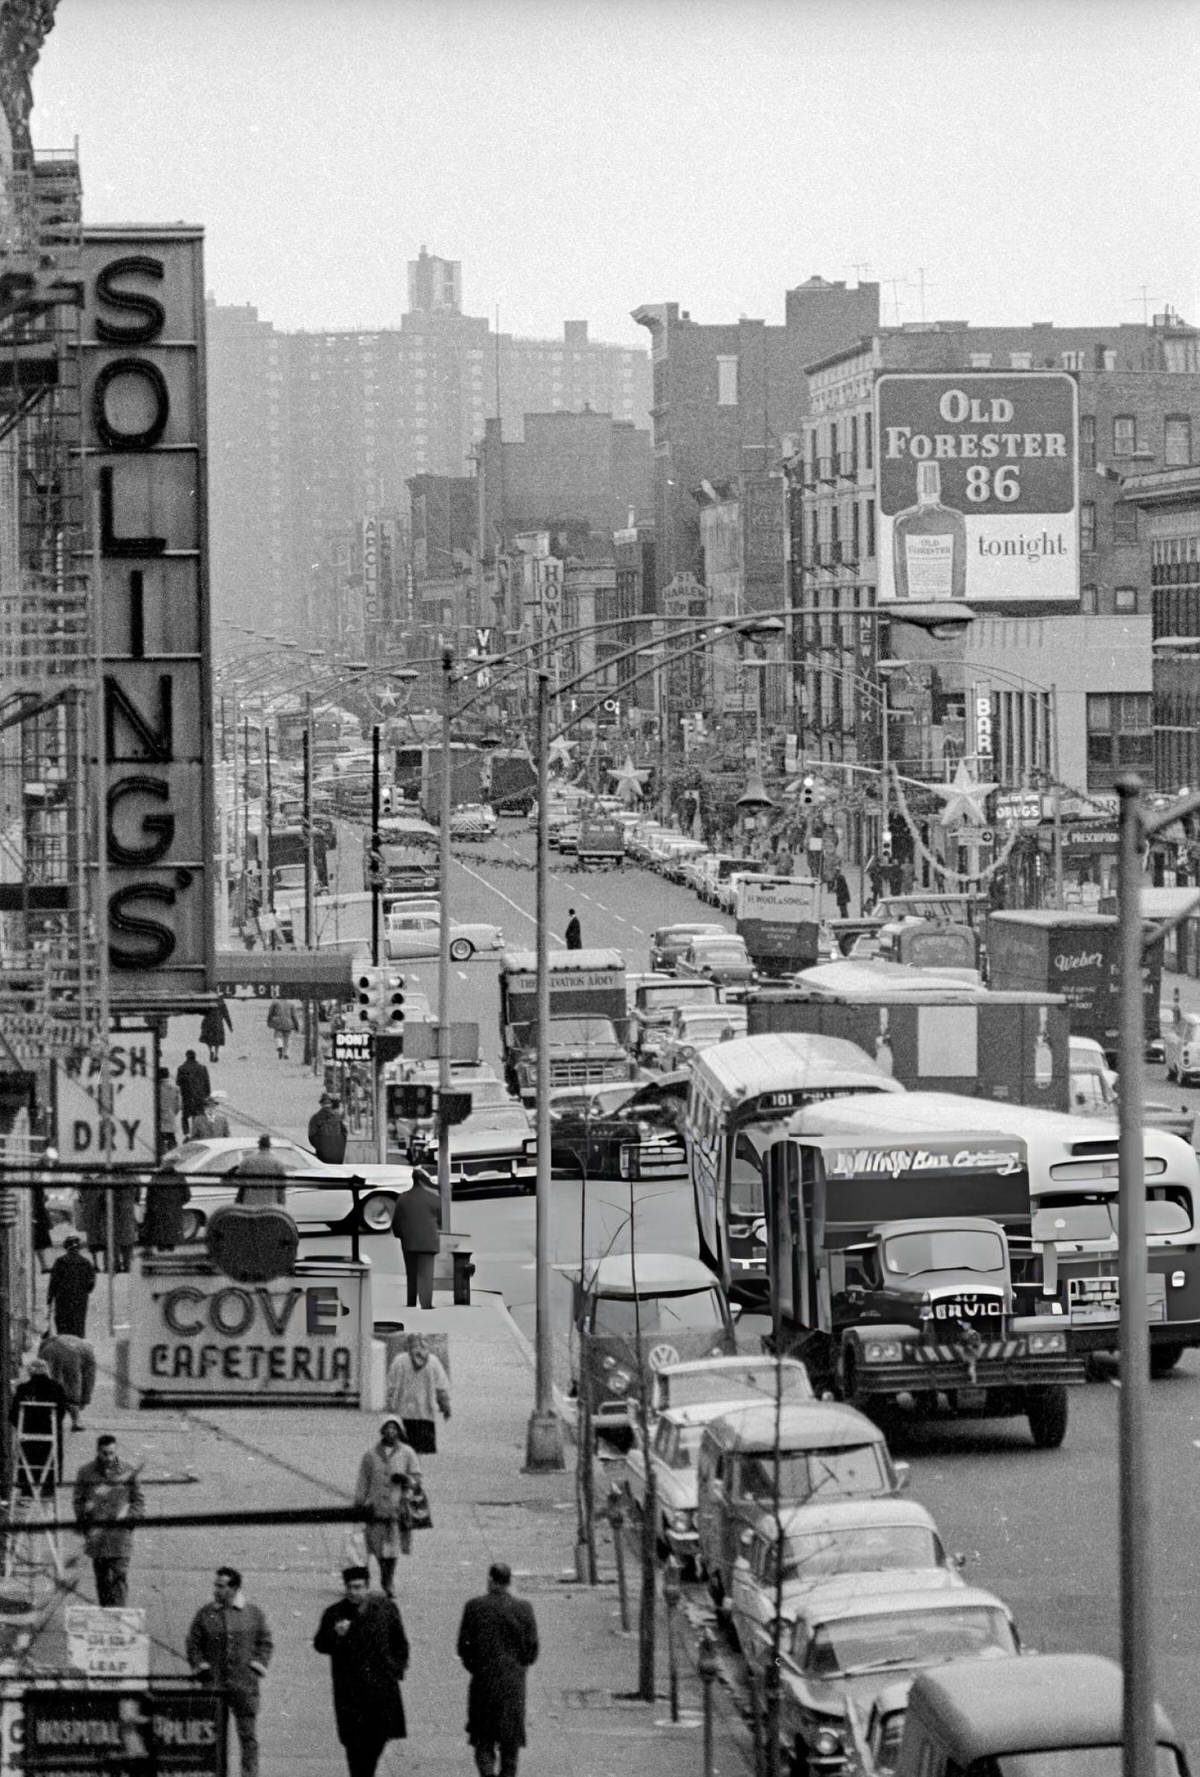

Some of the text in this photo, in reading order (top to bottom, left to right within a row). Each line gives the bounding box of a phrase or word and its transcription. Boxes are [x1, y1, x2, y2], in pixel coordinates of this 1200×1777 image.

[939, 389, 1015, 423] OLD
[885, 426, 1067, 459] FORESTER
[965, 465, 1021, 502] 86
[978, 531, 1068, 562] tonight
[859, 616, 873, 657] NEW
[860, 667, 873, 723] YORK
[976, 698, 992, 753] BAR
[996, 805, 1040, 819] DRUGS
[1054, 951, 1104, 972] Weber
[588, 973, 614, 987] ARMY
[335, 1048, 371, 1060] WALK
[336, 1033, 369, 1046] DONT
[772, 1092, 793, 1106] 101
[74, 1119, 141, 1151] DRY
[162, 1285, 344, 1337] COVE
[149, 1343, 352, 1382] CAFETERIA
